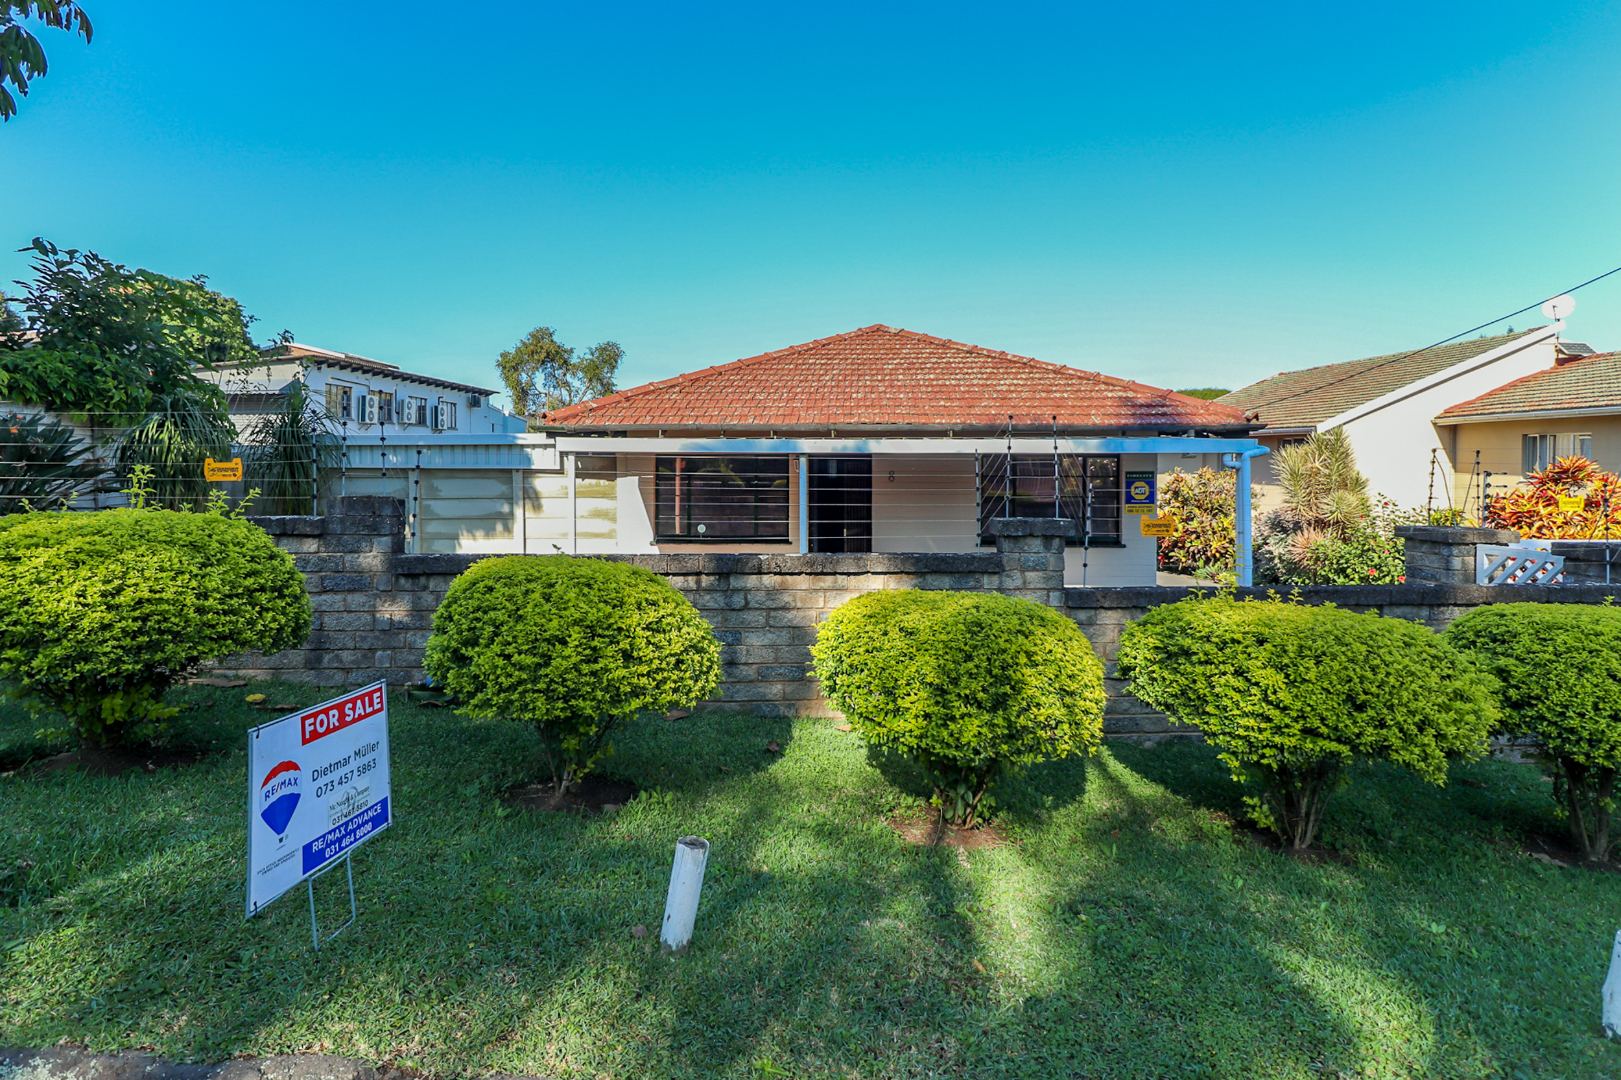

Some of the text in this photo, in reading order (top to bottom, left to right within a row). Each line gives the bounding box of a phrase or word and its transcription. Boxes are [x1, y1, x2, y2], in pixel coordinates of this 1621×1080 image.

[305, 691, 382, 739] FOR SALE
[312, 741, 380, 783] Dietmar Müller
[316, 758, 377, 798] 073 457 5863
[264, 777, 299, 802] RE/MAX
[312, 824, 346, 853] RE/MAX
[347, 802, 382, 832] ADVANCE
[325, 842, 340, 858] 031
[340, 832, 355, 848] 464
